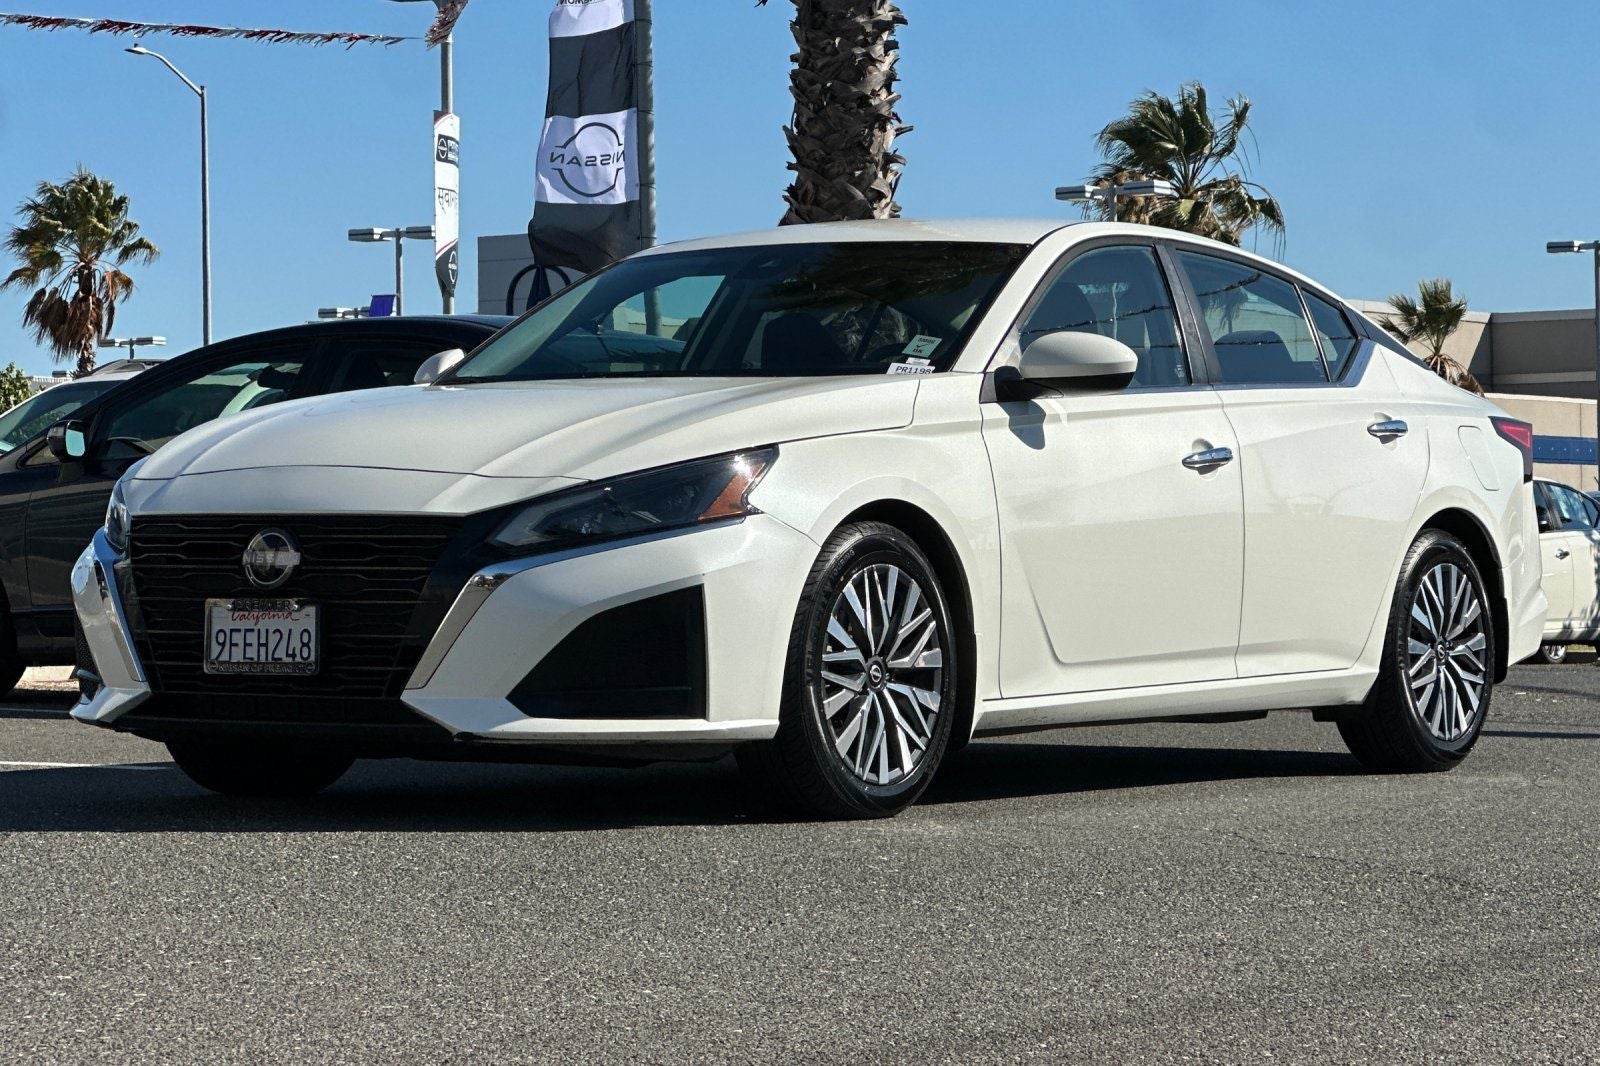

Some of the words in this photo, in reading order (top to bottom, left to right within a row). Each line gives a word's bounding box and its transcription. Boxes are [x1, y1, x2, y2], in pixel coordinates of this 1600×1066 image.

[895, 366, 932, 374] PR1198
[231, 607, 300, 625] California
[214, 628, 312, 661] 9FEH248
